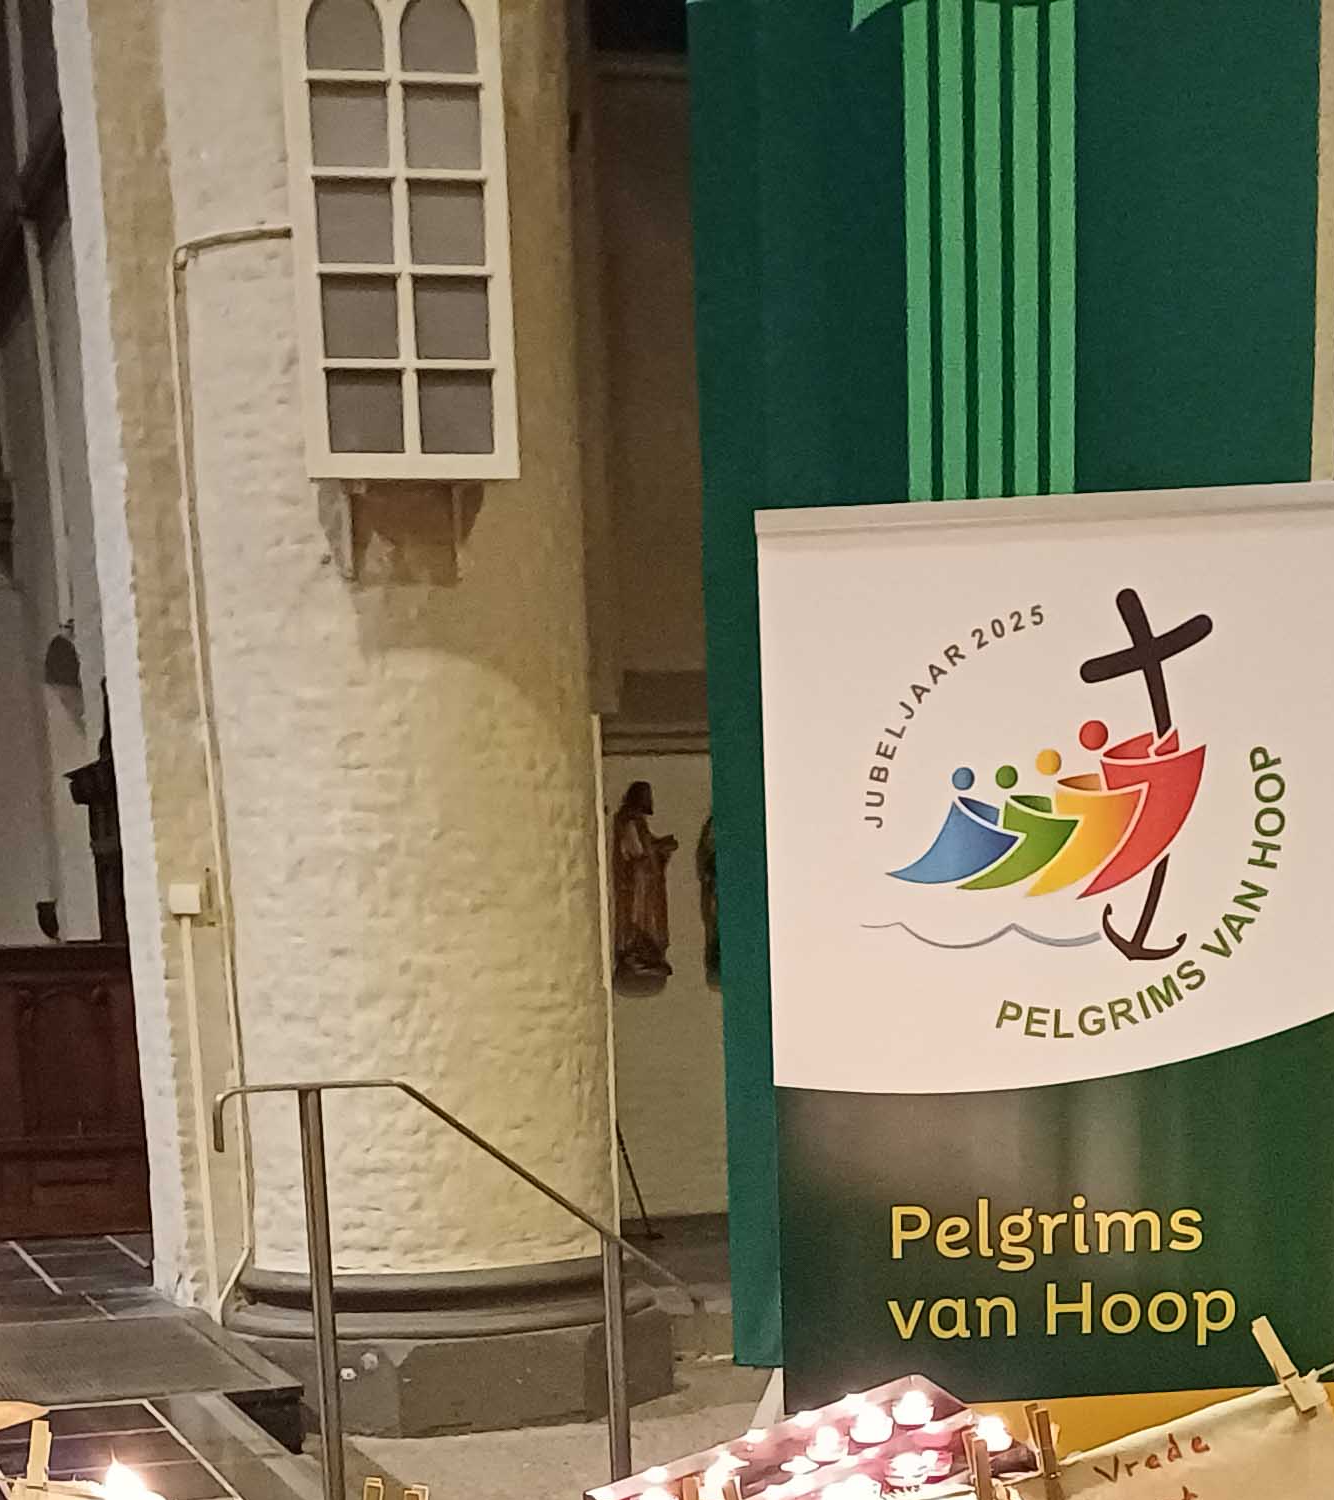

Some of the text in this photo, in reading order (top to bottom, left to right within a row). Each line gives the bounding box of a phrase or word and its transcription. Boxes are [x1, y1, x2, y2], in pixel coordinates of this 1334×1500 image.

[863, 603, 1046, 830] JUBELJAAR 2025
[994, 745, 1287, 1040] PELGRIMS VAN HOOP
[890, 1194, 1205, 1272] Pelgrims
[886, 1280, 1238, 1347] van Hoop
[1093, 1432, 1213, 1485] Vrede
